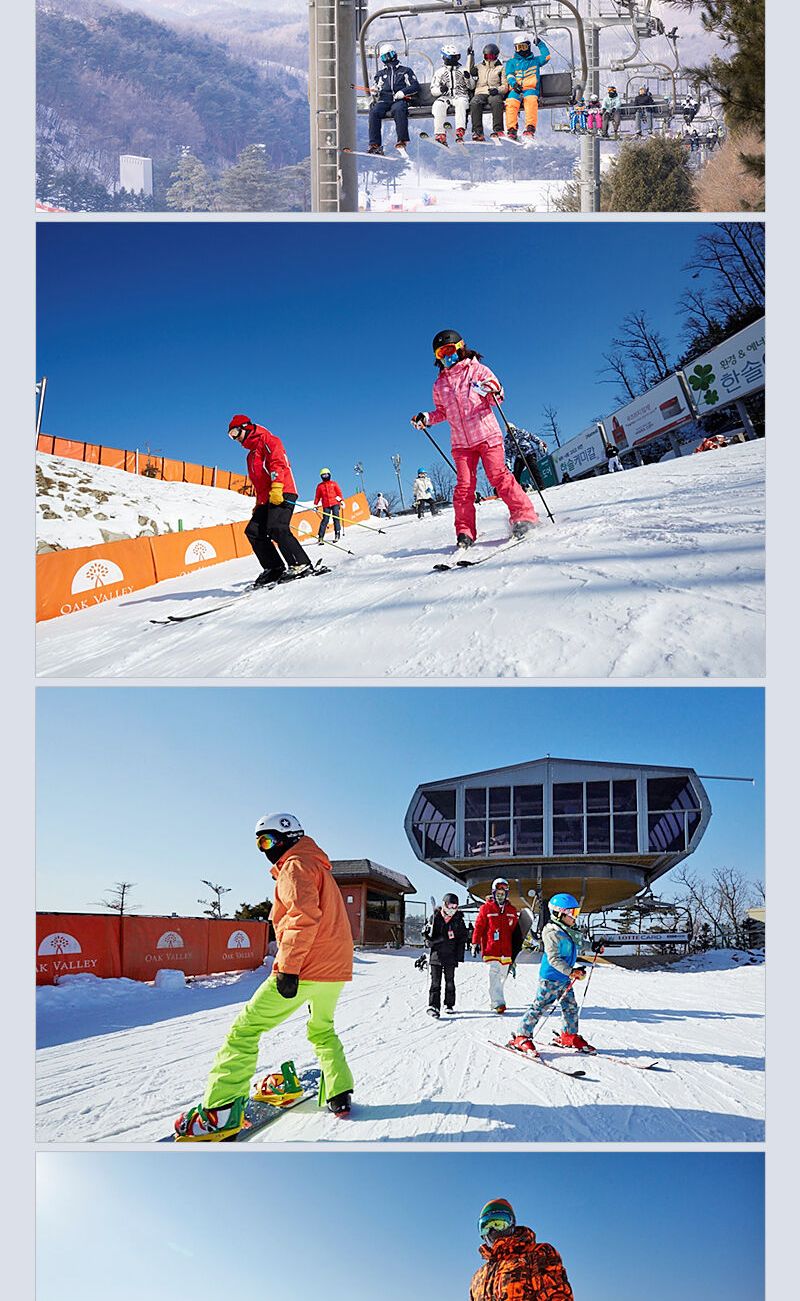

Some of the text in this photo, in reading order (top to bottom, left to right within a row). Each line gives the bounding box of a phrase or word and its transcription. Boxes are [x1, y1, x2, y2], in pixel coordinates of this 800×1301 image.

[720, 354, 737, 370] 환경
[738, 349, 746, 359] &
[720, 353, 766, 394] 한솔
[60, 586, 134, 615] OAK VALLEY
[53, 959, 98, 971] VALLEY
